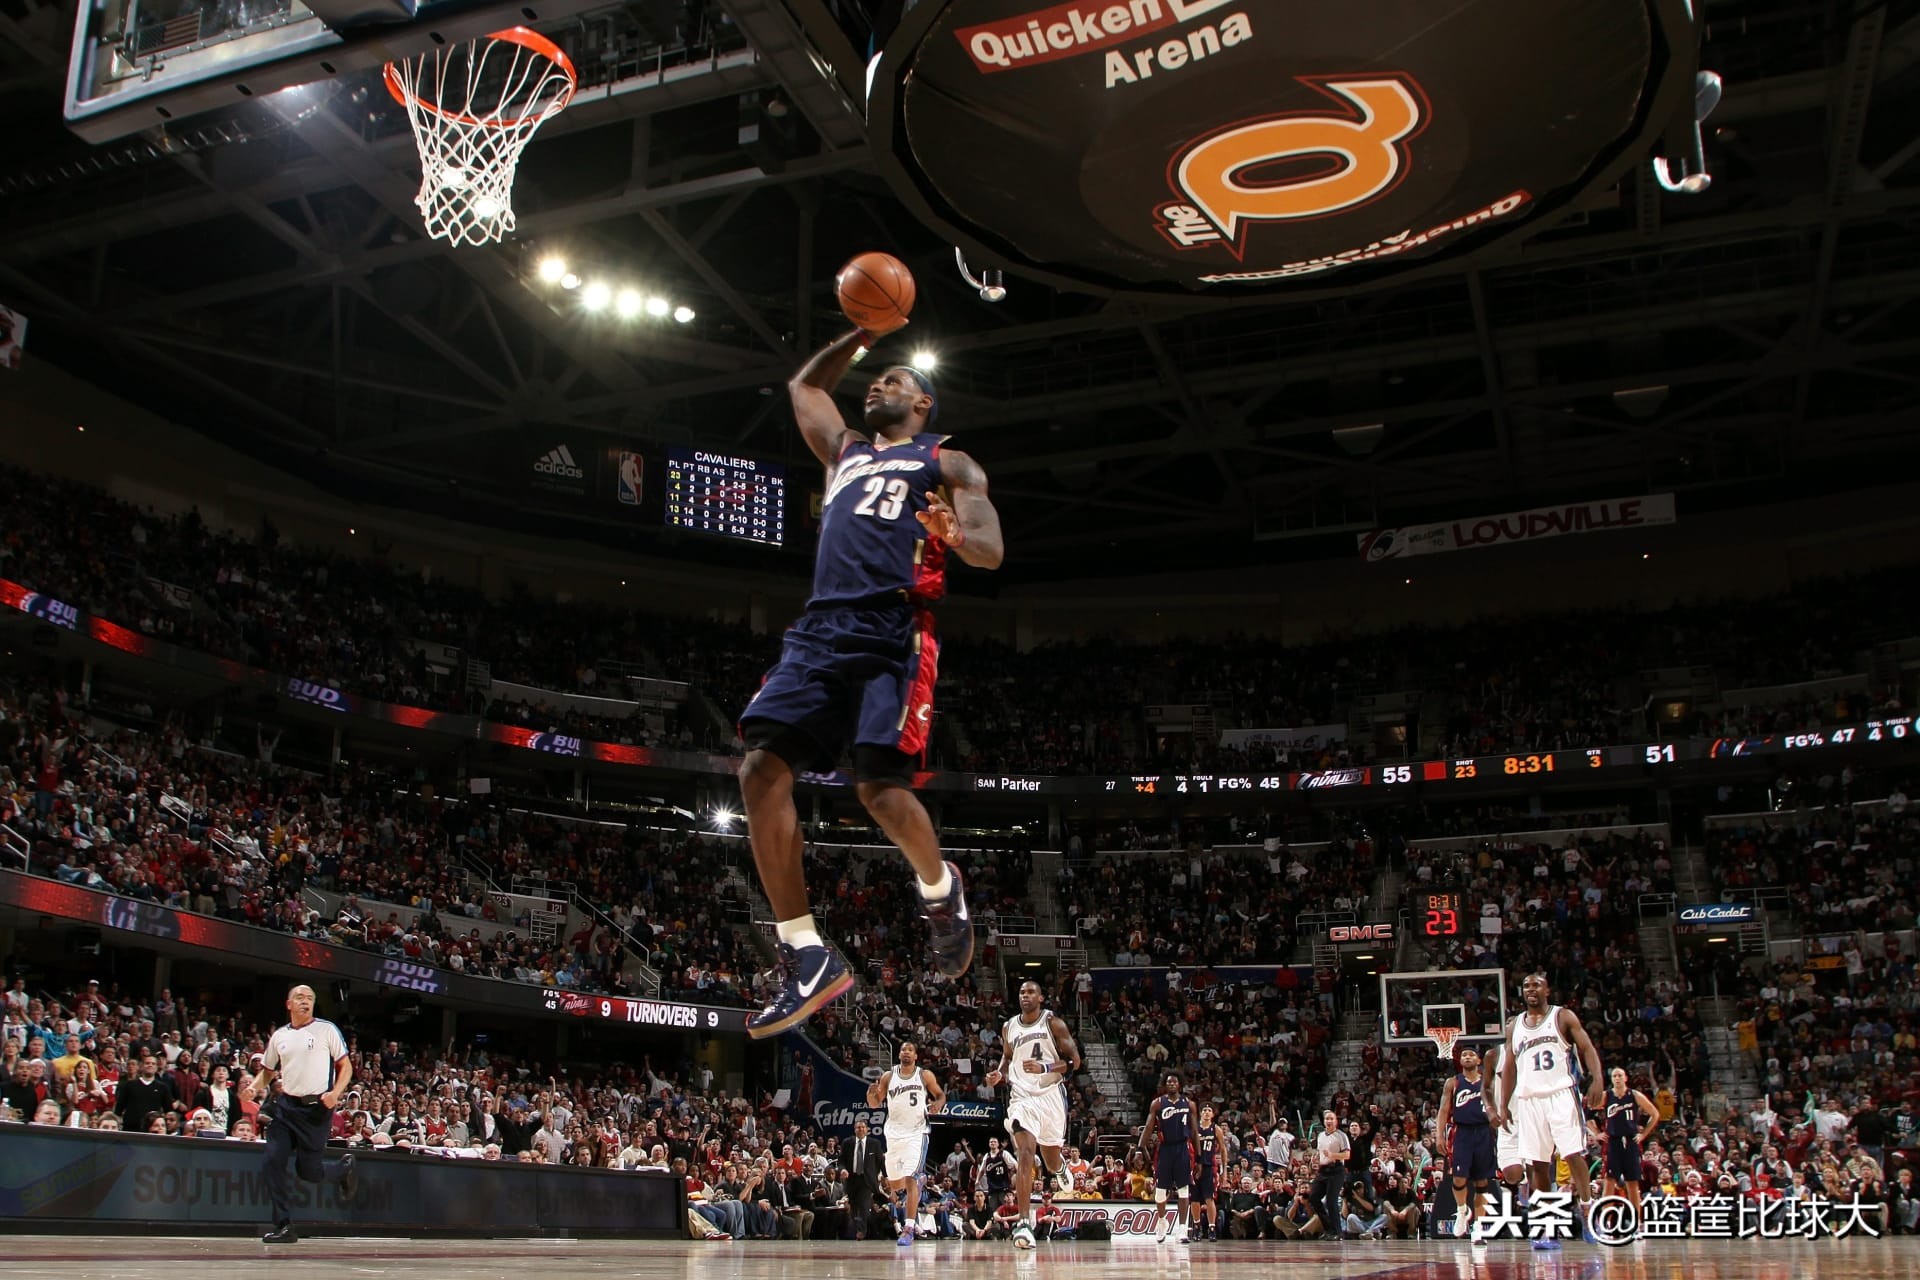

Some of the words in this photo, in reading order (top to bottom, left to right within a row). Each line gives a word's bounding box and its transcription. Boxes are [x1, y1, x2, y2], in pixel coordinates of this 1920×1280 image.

[970, 0, 1162, 66] Quicken
[1105, 11, 1252, 88] Arena
[1162, 204, 1222, 247] The
[694, 451, 757, 471] CAVALIERS
[533, 461, 583, 479] adidas
[668, 460, 681, 469] PL
[683, 462, 695, 471] PT
[697, 464, 710, 474] RB
[712, 467, 726, 477] AS
[733, 471, 747, 480] FG
[754, 474, 766, 483] FT
[771, 477, 784, 486] BK
[669, 492, 680, 502] 11
[777, 488, 783, 497] 0
[854, 476, 909, 520] 23
[753, 495, 768, 505] 0-0
[777, 499, 783, 508] 0
[683, 506, 694, 515] 14
[753, 518, 767, 527] 0-0
[776, 521, 782, 530] 0
[1451, 500, 1645, 548] LOUDVILLE
[776, 532, 782, 541] 0
[1886, 717, 1911, 726] FOULS
[1784, 732, 1824, 749] FG%
[1832, 728, 1856, 743] 47
[1868, 728, 1882, 741] 4
[1892, 725, 1906, 738] 0
[1646, 744, 1675, 764] 51
[1503, 754, 1554, 775] 8:31
[1589, 755, 1602, 768] 3
[1382, 766, 1412, 784] 55
[1455, 765, 1477, 779] 23
[977, 778, 996, 788] SAN
[1001, 777, 1041, 791] Parker
[1105, 781, 1116, 791] 27
[1135, 782, 1155, 793] +4
[1176, 782, 1188, 793] 4
[1199, 782, 1208, 793] 1
[1218, 778, 1252, 790] FG%
[1259, 777, 1280, 789] 45
[551, 903, 563, 913] 121
[1680, 908, 1706, 920] Cub
[1707, 907, 1752, 919] Cadet
[1425, 909, 1458, 936] 23
[1329, 923, 1394, 942] GMC
[545, 1000, 557, 1010] 45
[601, 1000, 612, 1018] 9
[625, 1001, 698, 1029] TURNOVERS
[707, 1011, 719, 1028] 9
[1030, 1042, 1044, 1061] 4
[1532, 1050, 1555, 1072] 13
[909, 1092, 918, 1107] 5
[950, 1103, 996, 1118] Cadet
[1624, 1109, 1634, 1121] 11
[1181, 1113, 1188, 1126] 4
